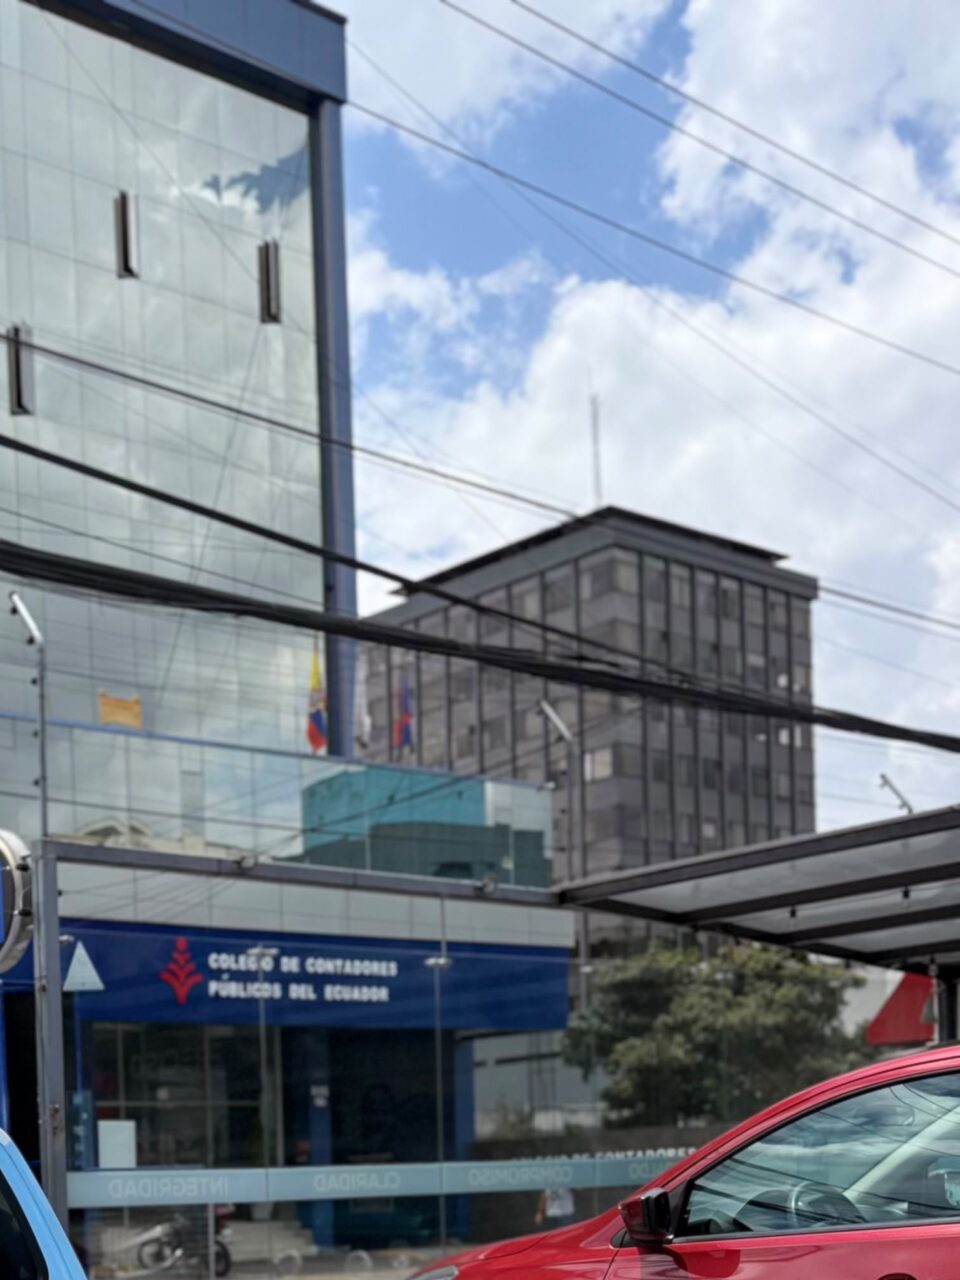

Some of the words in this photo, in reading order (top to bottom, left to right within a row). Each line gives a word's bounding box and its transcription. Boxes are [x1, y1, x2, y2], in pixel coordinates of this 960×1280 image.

[208, 951, 274, 973] COLEGO
[280, 956, 300, 974] DE
[305, 957, 398, 978] CONTADORES
[289, 983, 317, 1001] DEL
[324, 984, 390, 1002] ECUADOR
